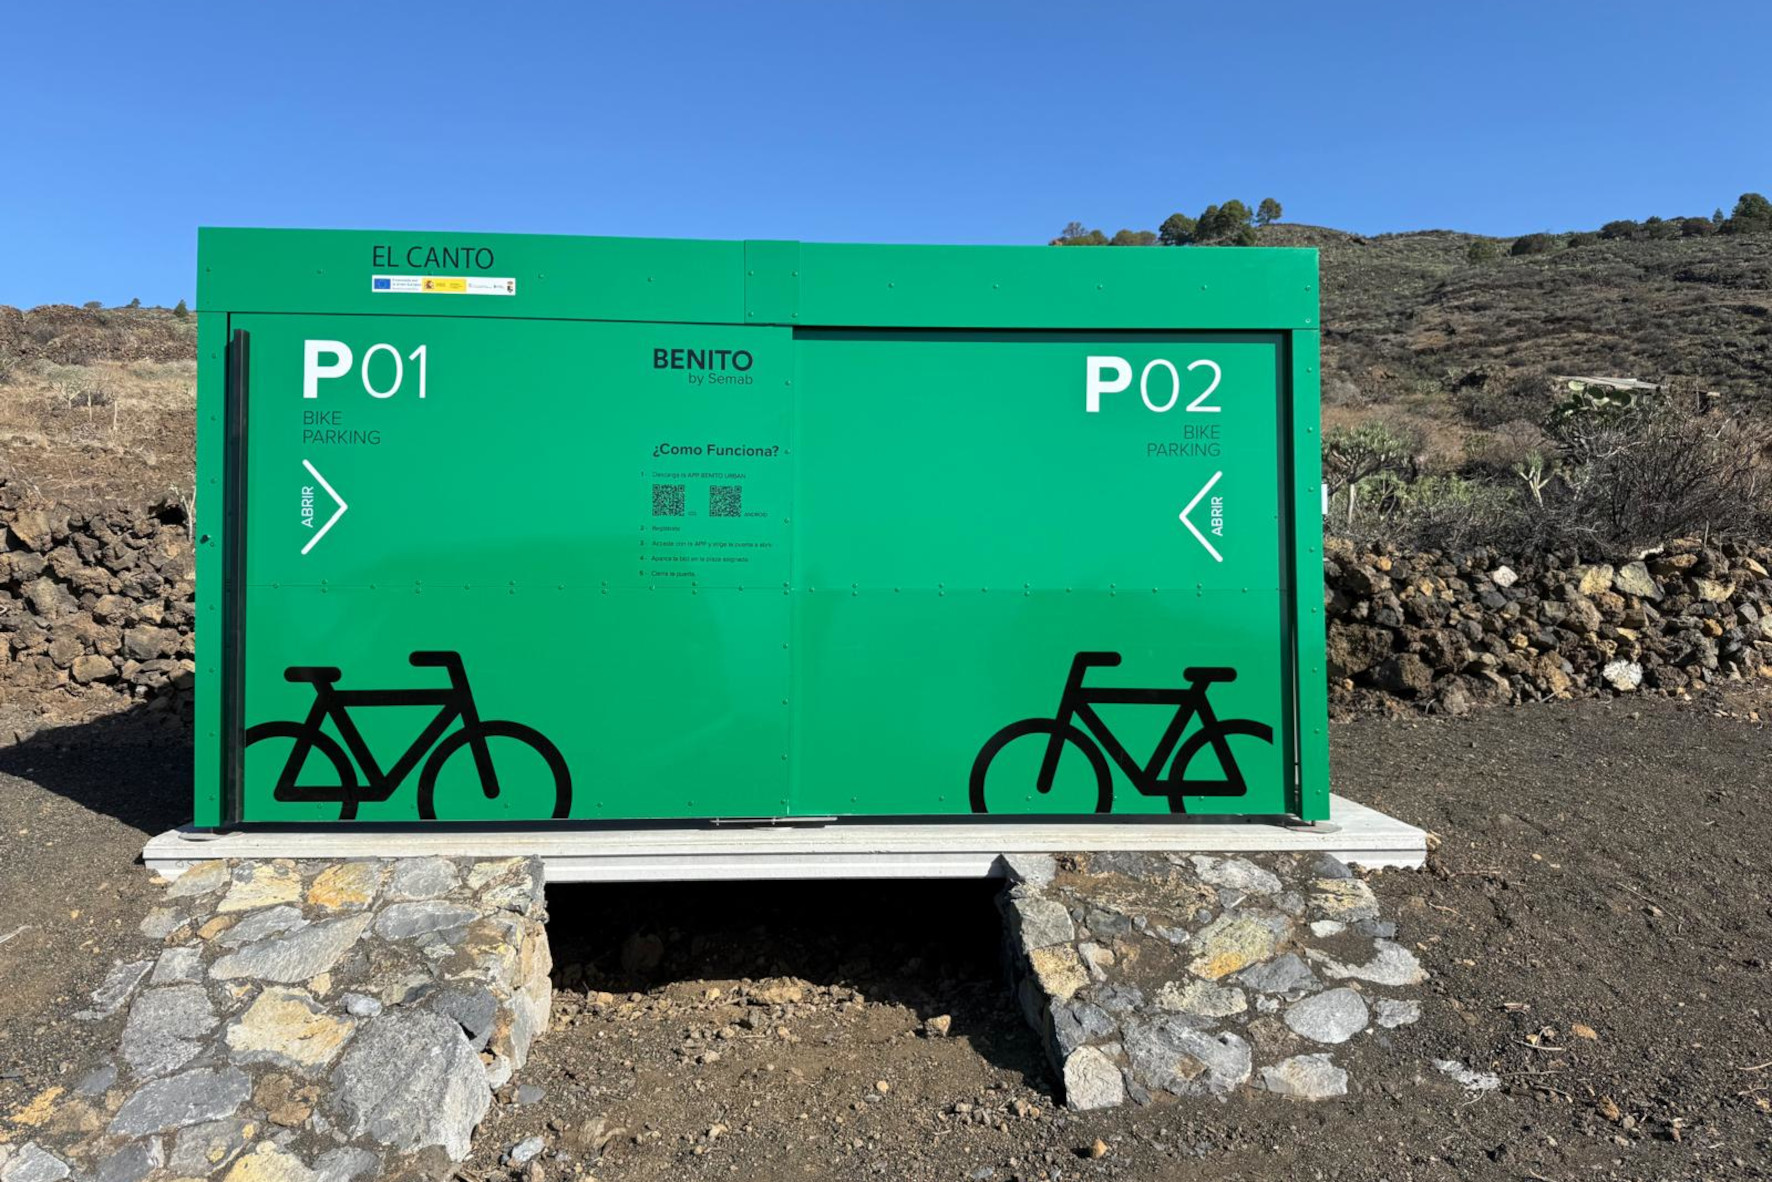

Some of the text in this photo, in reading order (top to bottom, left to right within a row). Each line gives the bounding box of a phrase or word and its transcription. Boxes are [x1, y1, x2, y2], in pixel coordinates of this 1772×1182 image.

[372, 246, 495, 270] EL CANTO
[653, 348, 754, 372] BENITO
[688, 373, 753, 386] by Semab
[303, 410, 342, 425] BIKE
[303, 429, 381, 445] PARKING
[1184, 424, 1221, 440] BIKE
[652, 443, 779, 457] ¿Como Funciona?
[1147, 442, 1221, 457] PARKING
[301, 486, 314, 528] ABRIR
[1210, 496, 1223, 537] ABRIR
